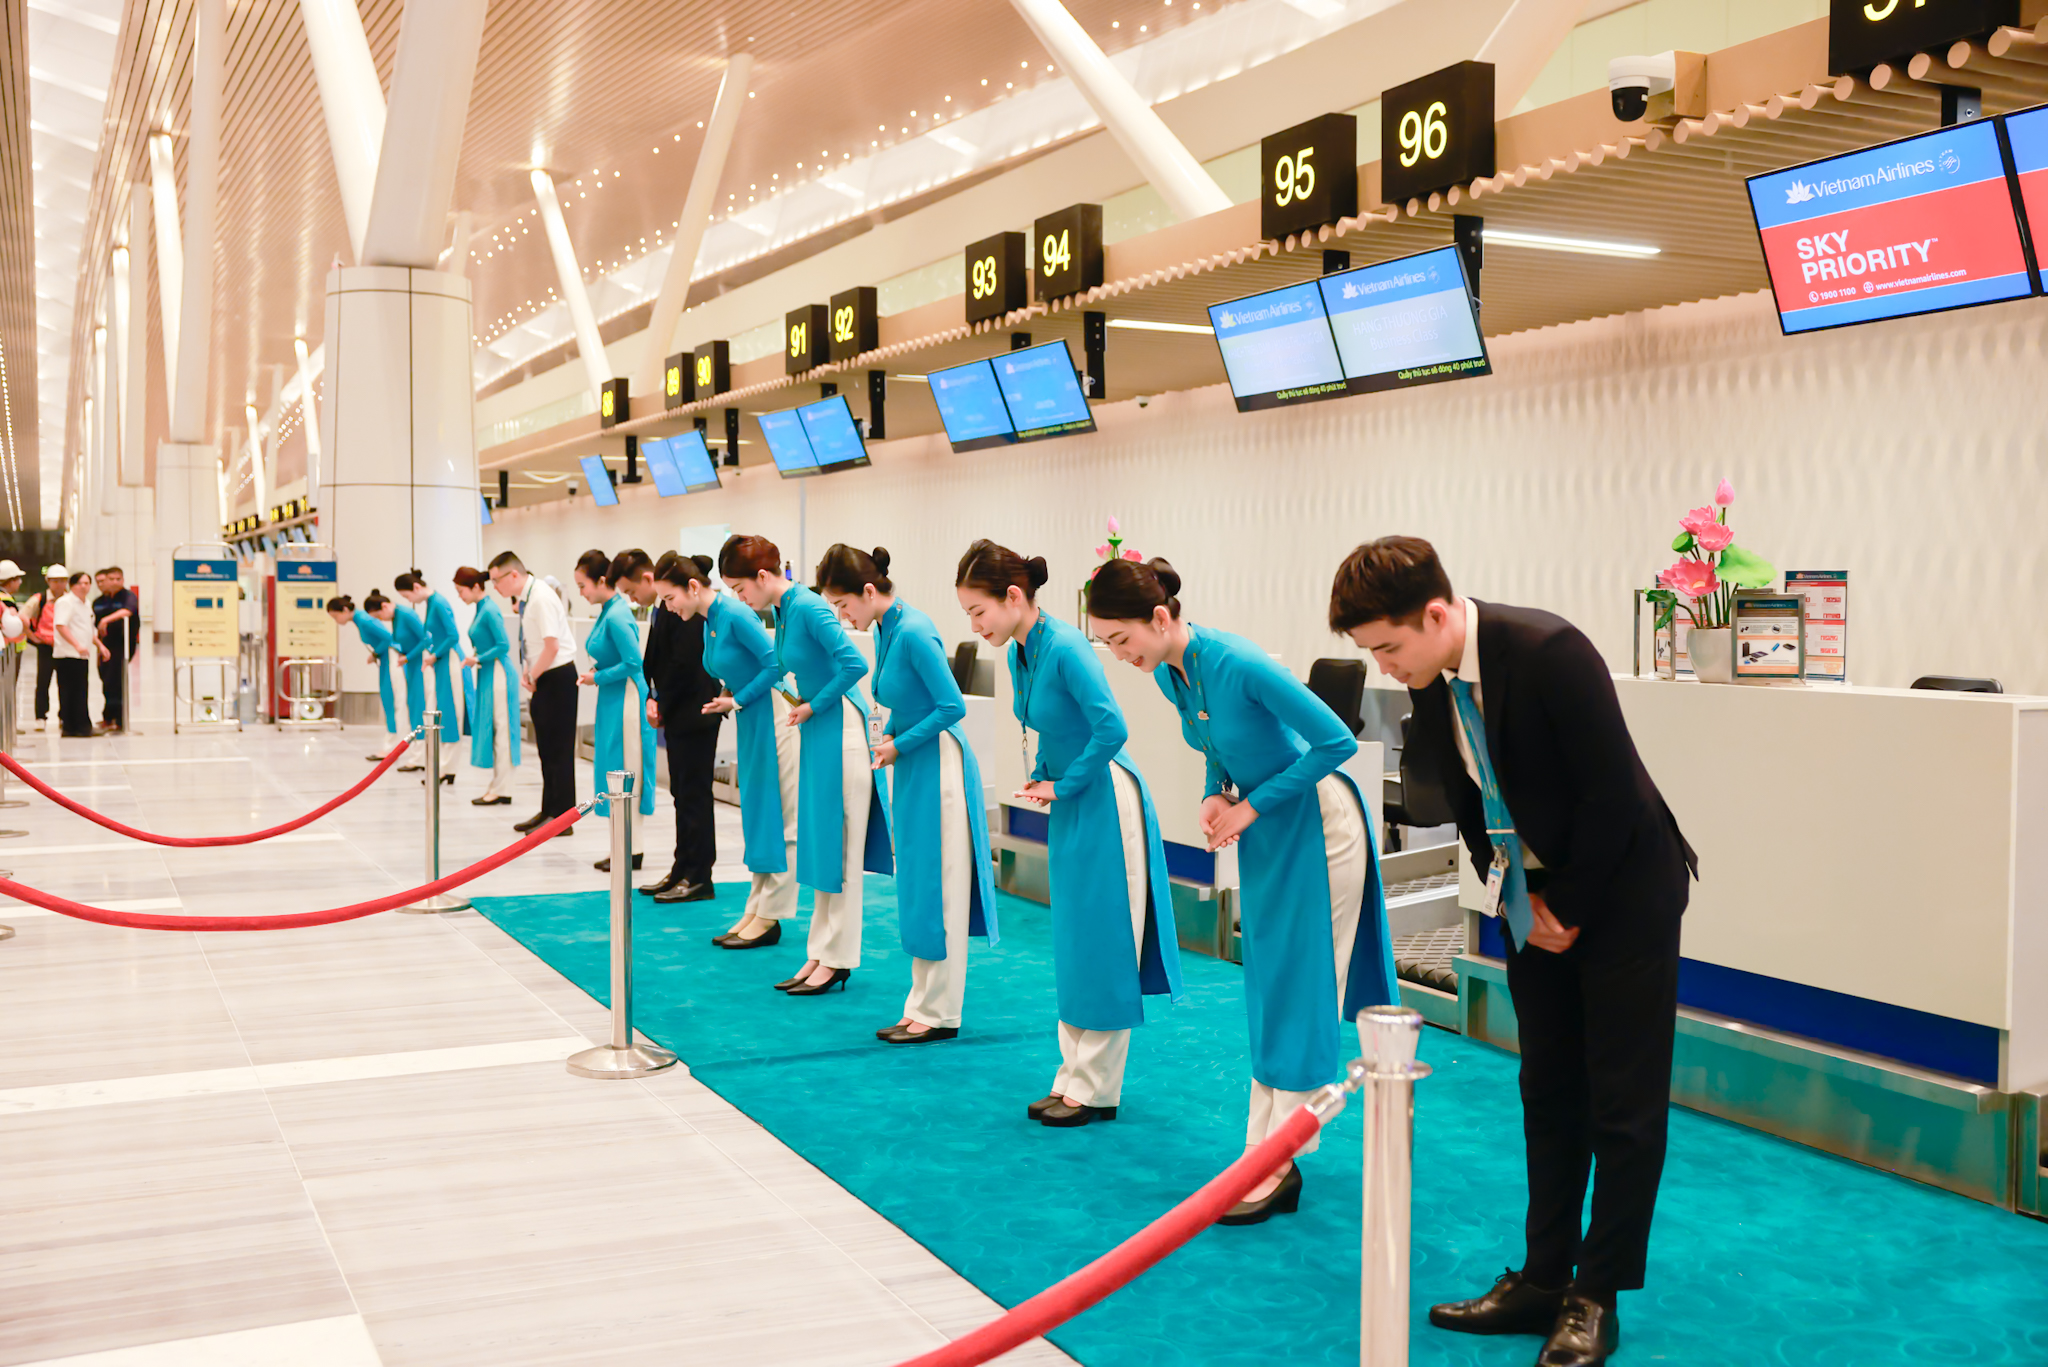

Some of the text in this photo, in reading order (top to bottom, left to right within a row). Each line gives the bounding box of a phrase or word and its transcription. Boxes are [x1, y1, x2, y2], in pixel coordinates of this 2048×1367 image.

[1399, 101, 1448, 168] 96
[1275, 146, 1315, 207] 95
[1812, 175, 1875, 198] Vietnam
[1876, 156, 1935, 185] Airlines
[1043, 229, 1071, 277] 94
[1796, 229, 1849, 260] SKY
[972, 256, 997, 300] 93
[1357, 271, 1426, 296] Vietnam Airlines
[1820, 269, 1967, 300] 1900 1100 www.vietnamairlines.com
[835, 305, 854, 343] 92
[1234, 309, 1270, 325] Vietnam
[1428, 305, 1448, 320] GIA
[790, 322, 806, 357] 91
[1370, 328, 1439, 351] Business Class
[697, 355, 711, 387] 90
